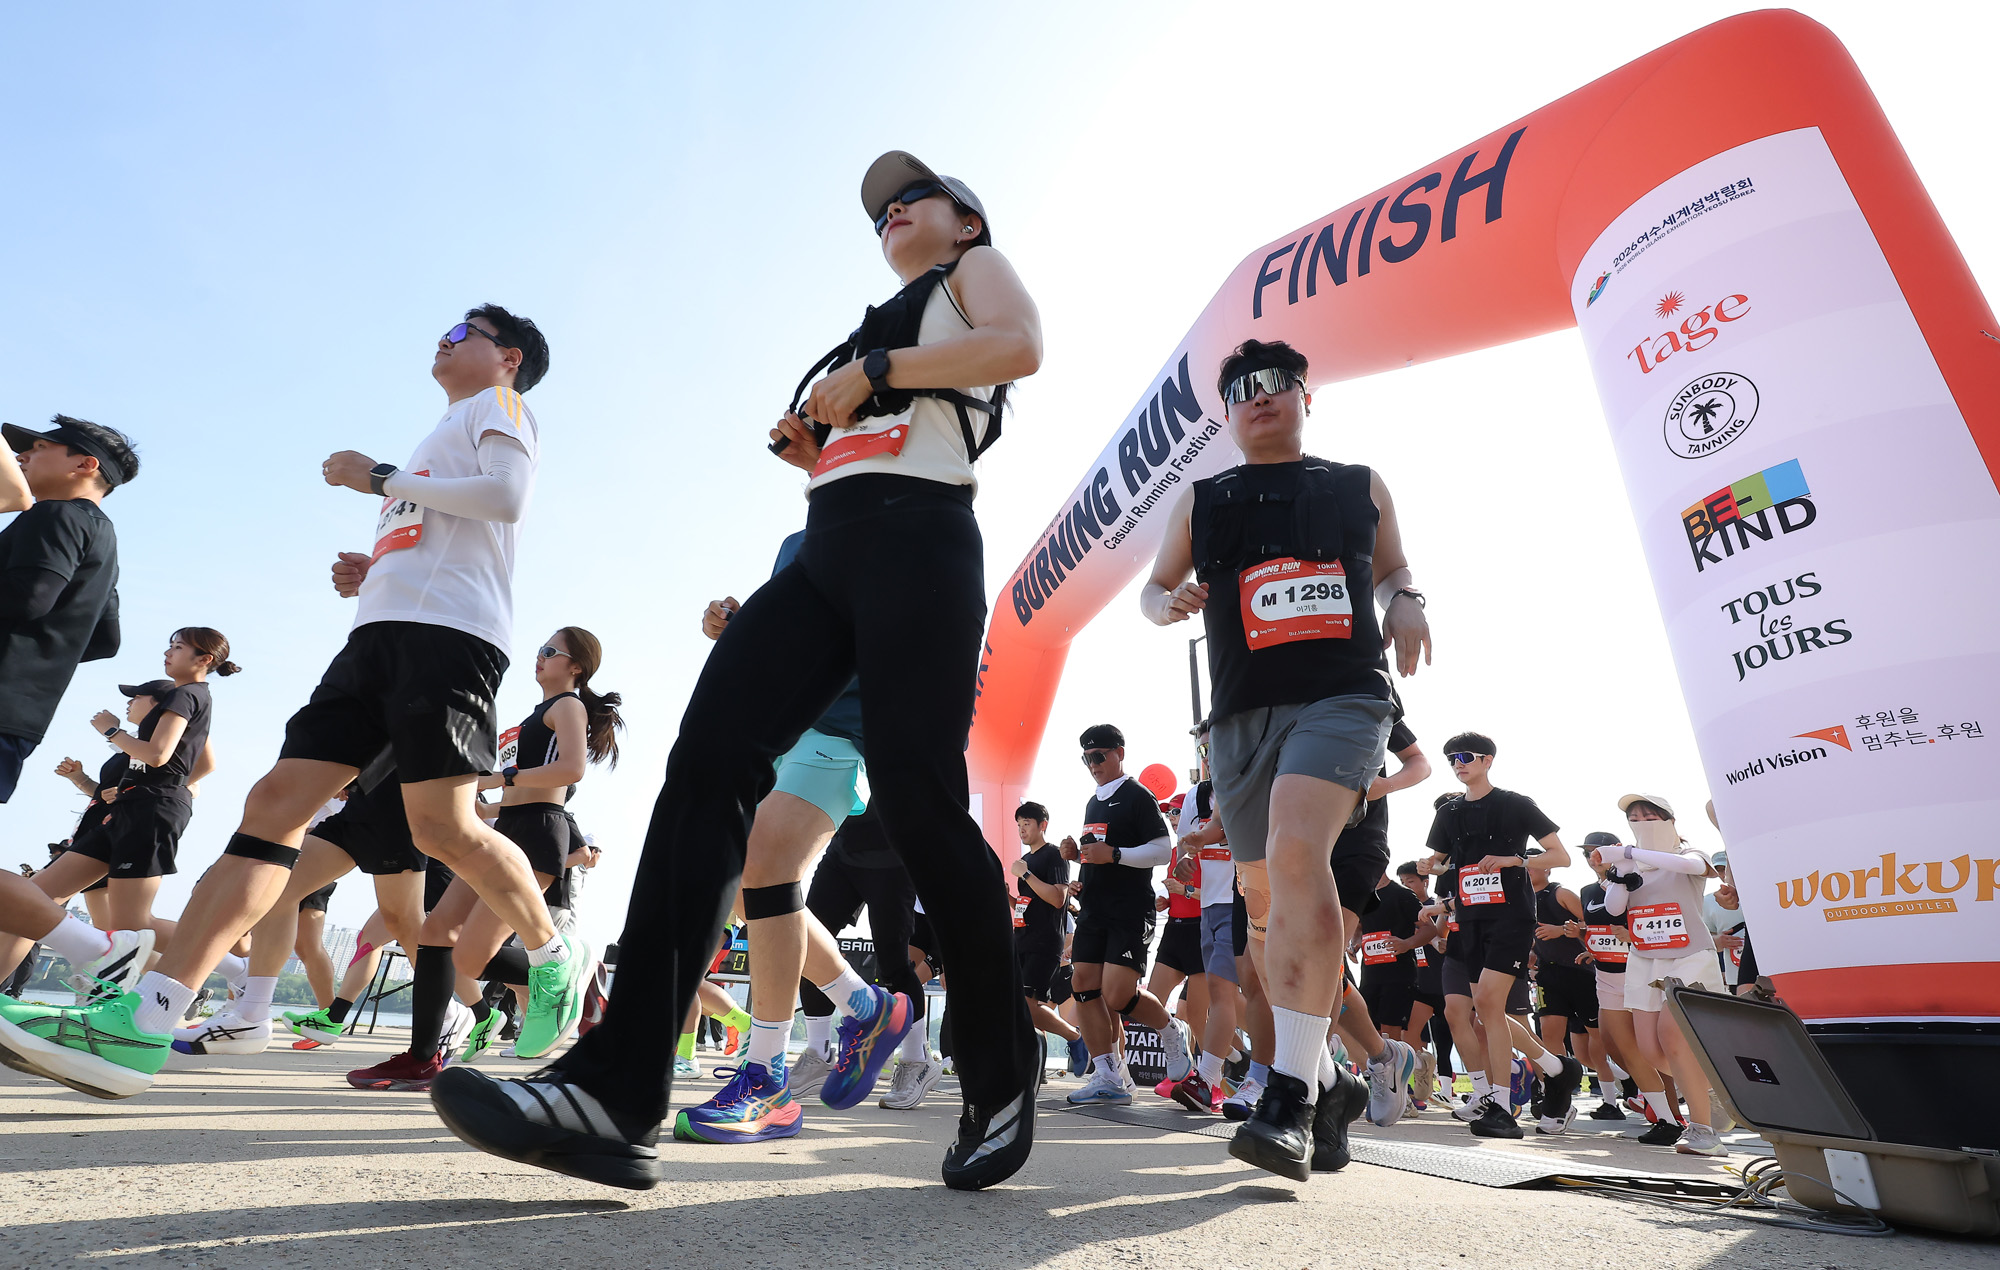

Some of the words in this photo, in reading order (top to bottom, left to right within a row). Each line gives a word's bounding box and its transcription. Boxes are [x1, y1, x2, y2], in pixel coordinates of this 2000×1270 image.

[1253, 126, 1528, 320] FINISH
[1613, 177, 1753, 268] 2026여수세계섬박람회
[1627, 247, 1645, 265] WORLD
[1645, 232, 1666, 249] ISLAND
[1666, 211, 1703, 235] EXHIBITION
[1703, 198, 1729, 213] YEOSU
[1729, 188, 1756, 201] KOREA
[1627, 294, 1751, 374] Tage
[1670, 377, 1738, 421] SUNBODY
[1687, 418, 1745, 454] TANNING
[1012, 466, 1122, 627] BURNING
[1118, 351, 1204, 498] RUN
[1104, 520, 1138, 551] Casual
[1134, 470, 1181, 518] Running
[1170, 418, 1222, 472] Festival
[1692, 497, 1817, 573] KIND
[1244, 564, 1280, 583] BURNING
[1281, 562, 1301, 573] RUN
[1261, 592, 1277, 607] M
[1285, 583, 1344, 603] 1298
[1721, 572, 1822, 624] TOUS
[1760, 614, 1793, 638] les
[1732, 619, 1853, 682] JOURS
[1855, 706, 1919, 731] 후원을
[1726, 758, 1765, 786] World
[1766, 747, 1827, 771] Vision
[1473, 877, 1499, 886] 2012
[1646, 919, 1682, 929] 4116
[1827, 905, 1888, 919] OUTDOOR
[1895, 901, 1951, 912] OUTLET
[1751, 1062, 1762, 1074] 3
